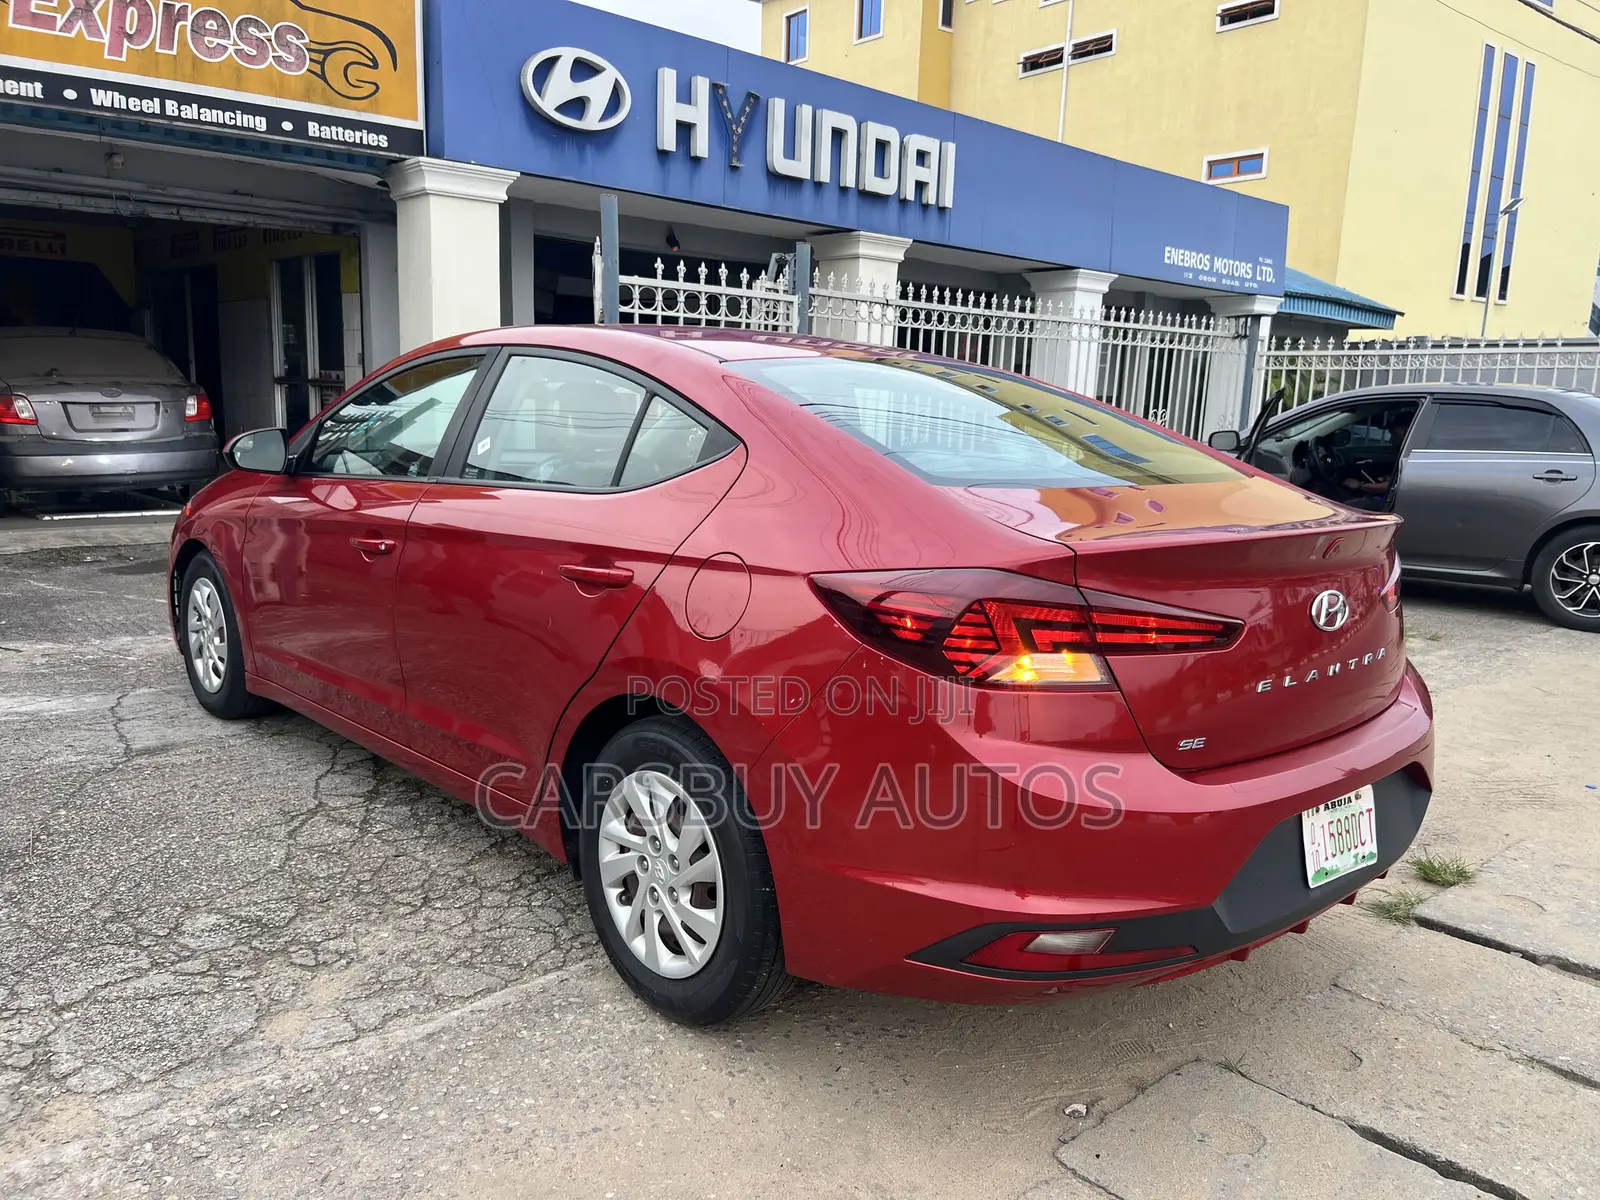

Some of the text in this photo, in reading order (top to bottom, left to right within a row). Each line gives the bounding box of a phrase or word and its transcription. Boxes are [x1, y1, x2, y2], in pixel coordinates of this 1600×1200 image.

[0, 79, 389, 148] ent Wheel Balancing Batteries
[656, 67, 957, 209] HYUNDAI
[1164, 246, 1210, 271] ENEBROS
[1213, 256, 1252, 279] MOTORS
[1256, 647, 1388, 693] ELANTRA
[1177, 737, 1207, 751] SE
[1323, 795, 1353, 812] ABUJA
